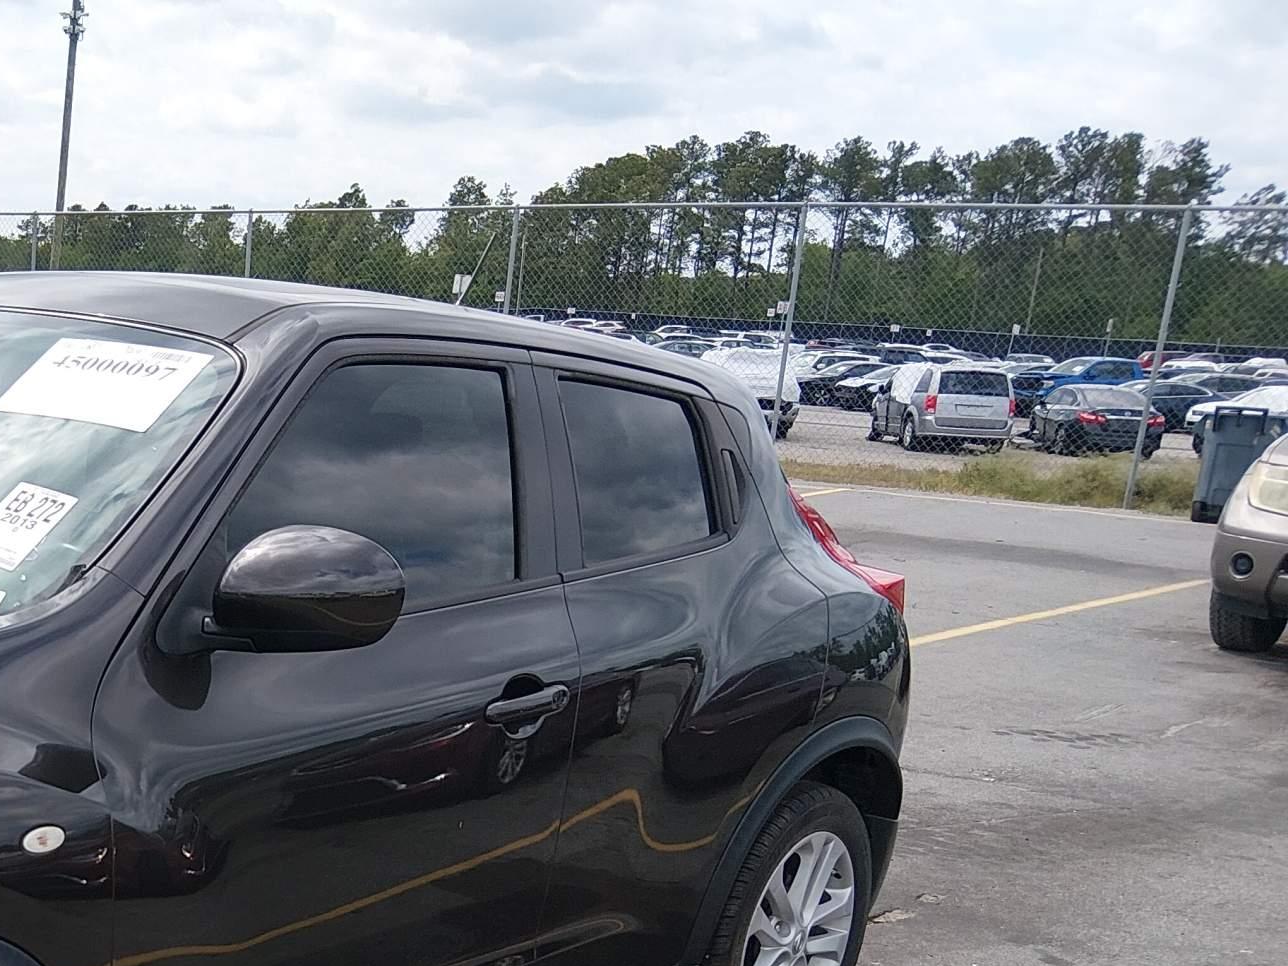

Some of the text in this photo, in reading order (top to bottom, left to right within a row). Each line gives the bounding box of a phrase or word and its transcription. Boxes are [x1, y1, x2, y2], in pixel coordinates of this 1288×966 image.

[52, 354, 179, 381] 45000097
[5, 489, 36, 514] EB
[26, 496, 67, 524] 272
[0, 512, 38, 530] 2013
